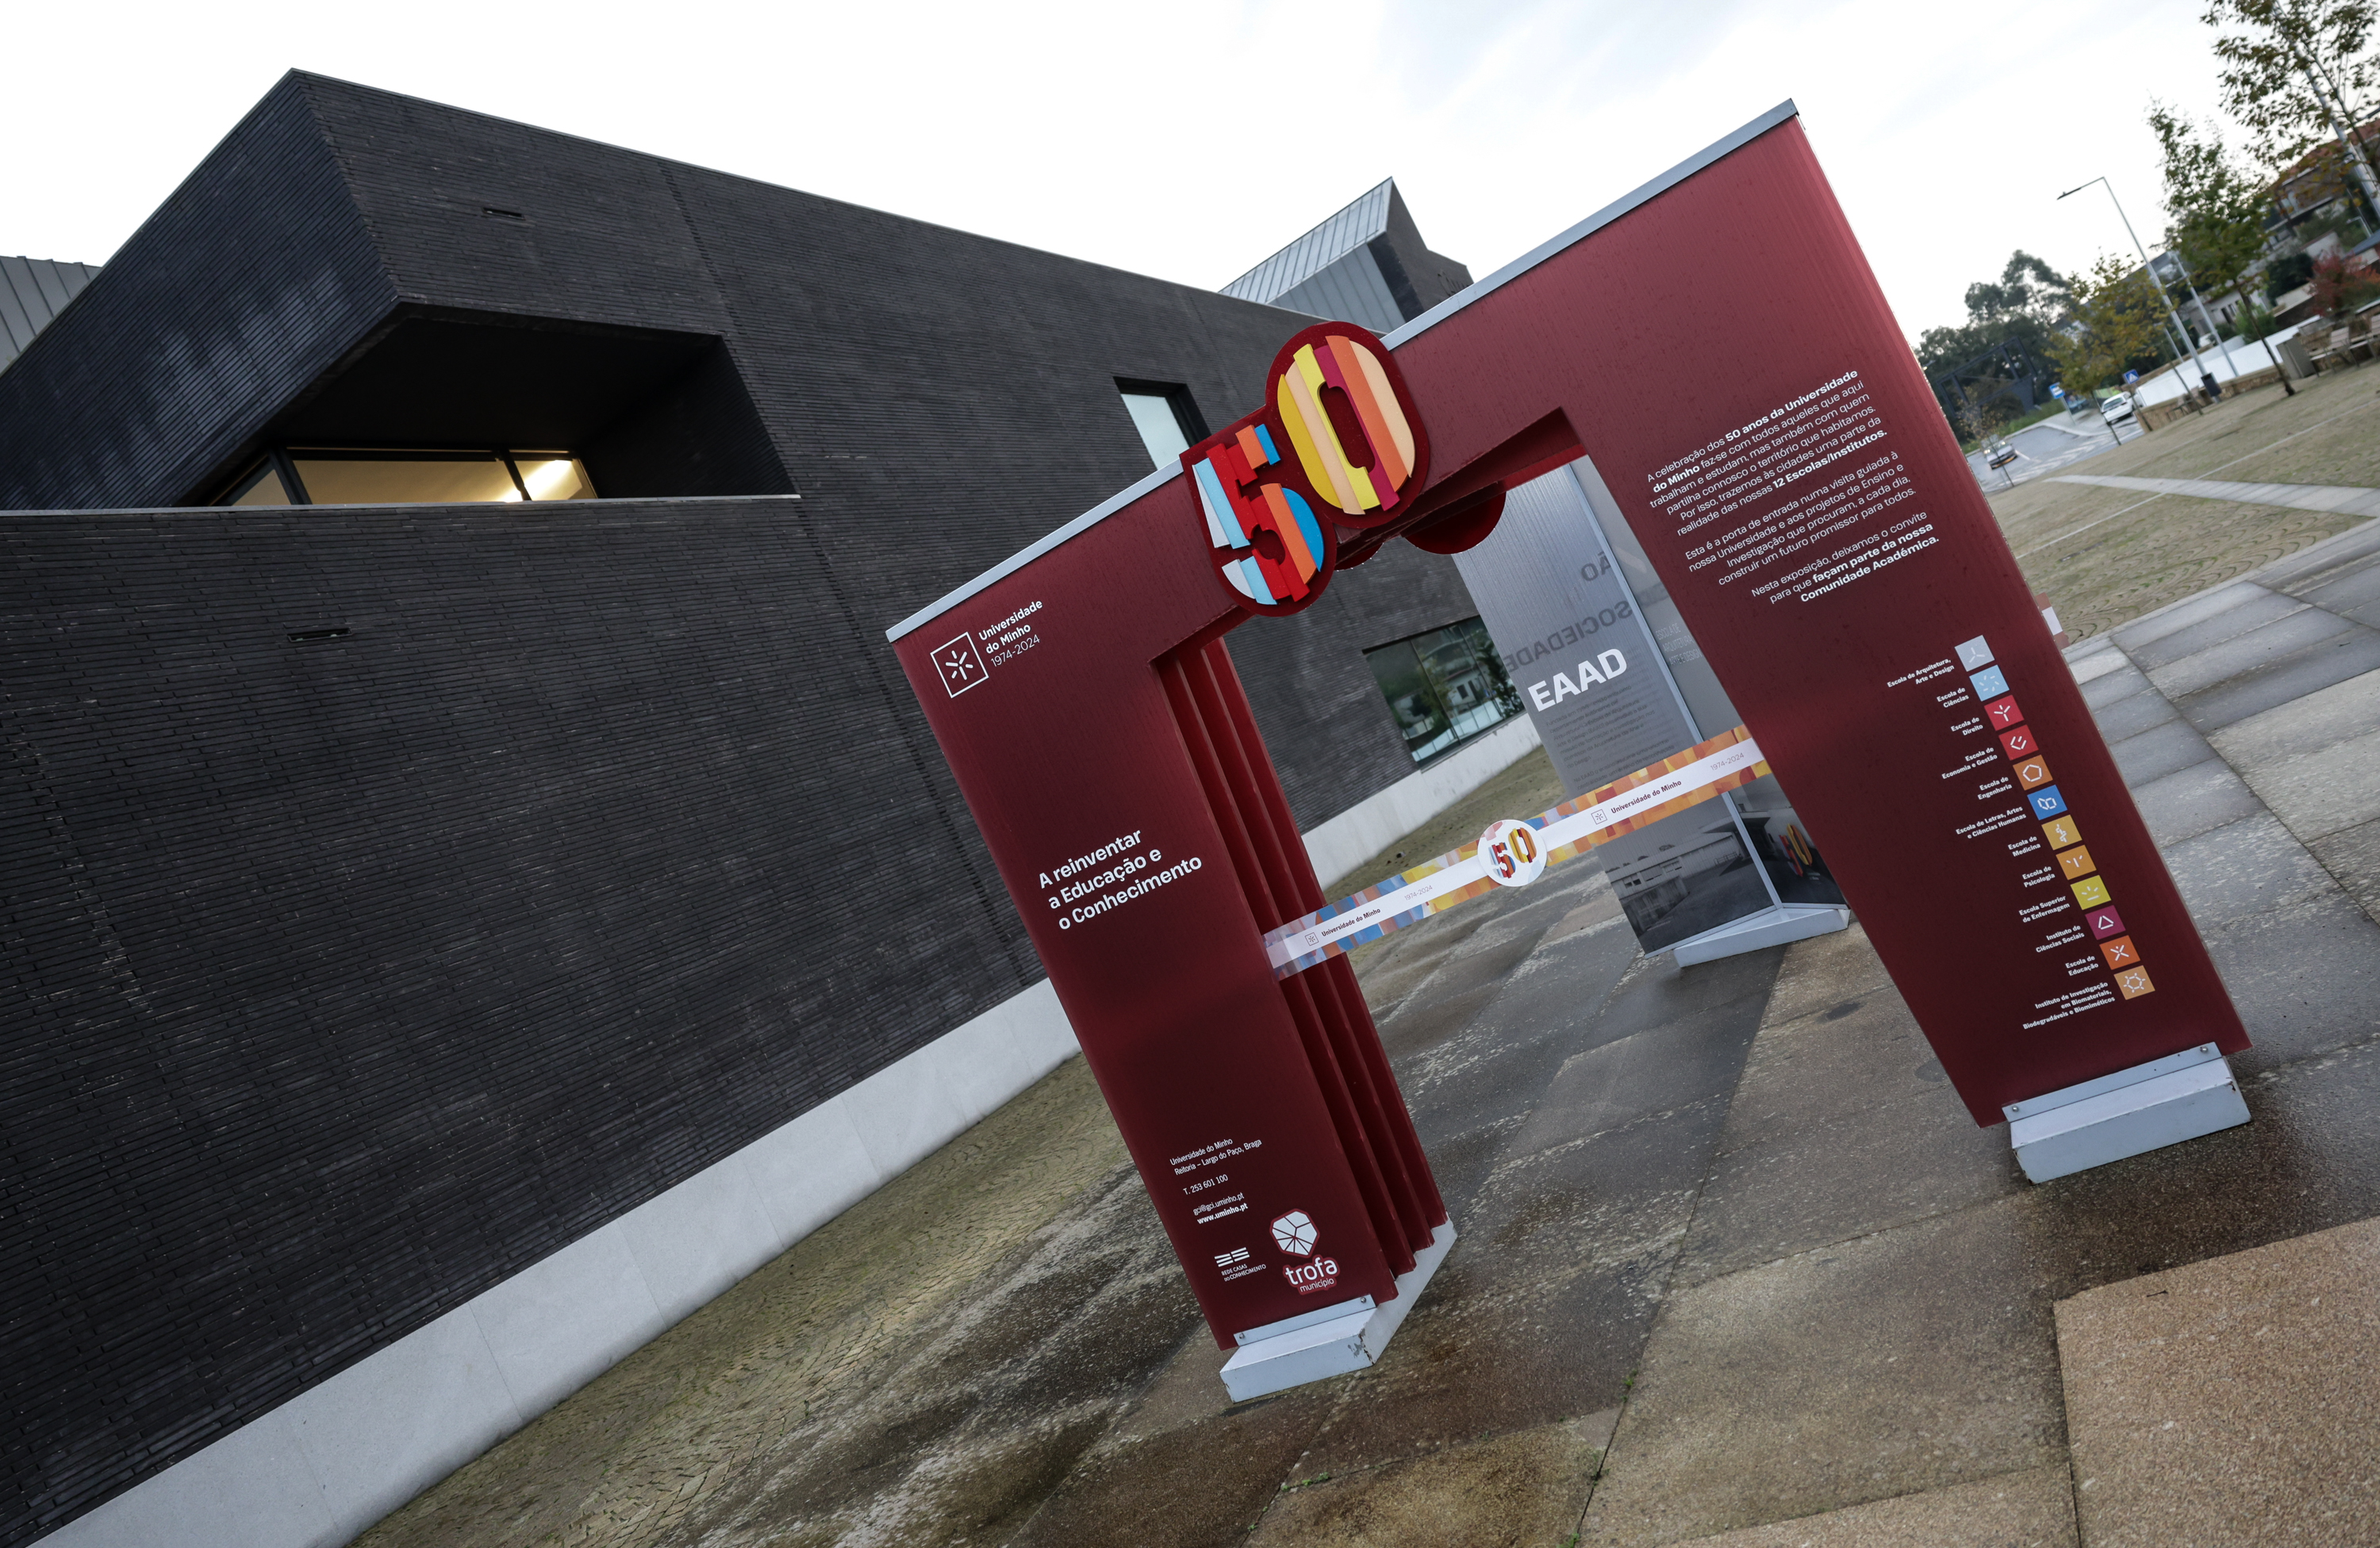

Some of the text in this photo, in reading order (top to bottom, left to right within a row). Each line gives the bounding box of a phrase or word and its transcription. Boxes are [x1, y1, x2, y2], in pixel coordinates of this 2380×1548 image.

[1648, 371, 1858, 482] A celebração dos 50 anos da Universidade
[1653, 380, 1864, 493] do Minho faz-se com todos aqueles que aqui
[1649, 481, 1697, 508] trabalham
[1705, 455, 1749, 481] estudam,
[1749, 443, 1772, 459] mas
[1771, 421, 1814, 447] também
[1814, 409, 1839, 425] com
[1839, 394, 1870, 413] quem
[1666, 492, 1702, 515] partilha
[1702, 469, 1749, 496] connosco
[1757, 444, 1799, 468] território
[1800, 432, 1820, 447] que
[1820, 405, 1876, 436] habitamos.
[1192, 335, 1415, 605] 50
[1677, 429, 1887, 536] realidade das nossas 12 Escolas/Institutos.
[1679, 417, 1881, 520] Por isso, trazemos às cidades uma parte da
[1685, 546, 1706, 560] Esta
[1706, 540, 1714, 550] é
[1722, 526, 1748, 544] porta
[1748, 519, 1761, 530] de
[1762, 501, 1799, 523] entrada
[1799, 486, 1829, 505] numa
[1829, 473, 1856, 490] visita
[1856, 456, 1891, 479] guiada
[1891, 451, 1898, 460] à
[1688, 555, 1717, 572] nossa
[1716, 525, 1777, 558] Universidade
[1786, 512, 1805, 525] aos
[1805, 492, 1846, 517] projetos
[1846, 485, 1860, 496] de
[1860, 468, 1895, 489] Ensino
[1726, 536, 1786, 567] Investigação
[1786, 525, 1806, 540] que
[1806, 501, 1858, 531] procuram,
[1866, 485, 1891, 501] cada
[1892, 476, 1911, 489] dia,
[1718, 488, 1916, 586] construir um futuro promissor para todos.
[1751, 580, 1779, 597] Nesta
[1780, 557, 1832, 584] exposição,
[1831, 533, 1880, 560] deixamos
[1890, 512, 1927, 533] convite
[1769, 524, 1933, 605] para que façam parte da nossa
[1800, 536, 1940, 602] Comunidade Académica.
[978, 601, 1042, 640] Universidade
[985, 624, 1031, 654] do Minho
[990, 634, 1040, 667] 1974-2024
[1528, 648, 1628, 712] EAAD
[1887, 676, 1907, 688] Escola
[1915, 659, 1952, 676] Arquitetura,
[1915, 676, 1929, 685] Arte
[1933, 665, 1955, 677] Design
[1943, 694, 1969, 708] Ciências
[1962, 724, 1983, 736] Direito
[1710, 751, 1745, 770] 1974-2024
[1941, 765, 1971, 779] Economia
[1975, 755, 1998, 766] Gestão
[1610, 793, 1652, 814] Universidade
[1660, 781, 1682, 793] Minho
[1977, 784, 2013, 800] Engenharia
[1955, 824, 1976, 835] Escola
[1984, 813, 2006, 824] Letras,
[2006, 806, 2023, 816] Artes
[1971, 824, 1998, 837] Ciências
[1997, 813, 2027, 828] Humanas
[1039, 829, 1141, 889] A reinventar
[1489, 828, 1537, 878] 50
[2012, 843, 2041, 857] Medicina
[1048, 849, 1161, 909] a Educação e
[1058, 857, 1202, 930] o Conhecimento
[1403, 885, 1433, 901] 1974-2024
[2023, 873, 2056, 888] Psicologia
[2018, 895, 2066, 916] Escola Superior
[2030, 903, 2071, 920] Enfermagem
[1321, 920, 1356, 937] Universidade
[1362, 908, 1381, 919] Minho
[2035, 932, 2085, 953] Ciências Sociais
[2067, 962, 2099, 976] Educação
[2034, 997, 2061, 1009] Instituto
[2069, 982, 2109, 998] Investigação
[2071, 989, 2112, 1006] Biomateriais,
[2022, 1011, 2069, 1030] Biodegradáveis
[2073, 997, 2116, 1013] Biomiméticos
[1169, 1148, 1206, 1166] Universidade
[1213, 1139, 1233, 1150] Minho
[1173, 1163, 1196, 1176] Reitoria
[1200, 1155, 1219, 1166] Largo
[1218, 1151, 1227, 1160] do
[1226, 1147, 1245, 1157] Paço,
[1243, 1139, 1262, 1150] Braga
[1190, 1182, 1203, 1193] 253
[1203, 1178, 1215, 1189] 601
[1215, 1173, 1229, 1184] 100
[1196, 1202, 1249, 1224] www.uminho.pt
[1284, 1257, 1338, 1285] trofa
[1299, 1277, 1334, 1293] município
